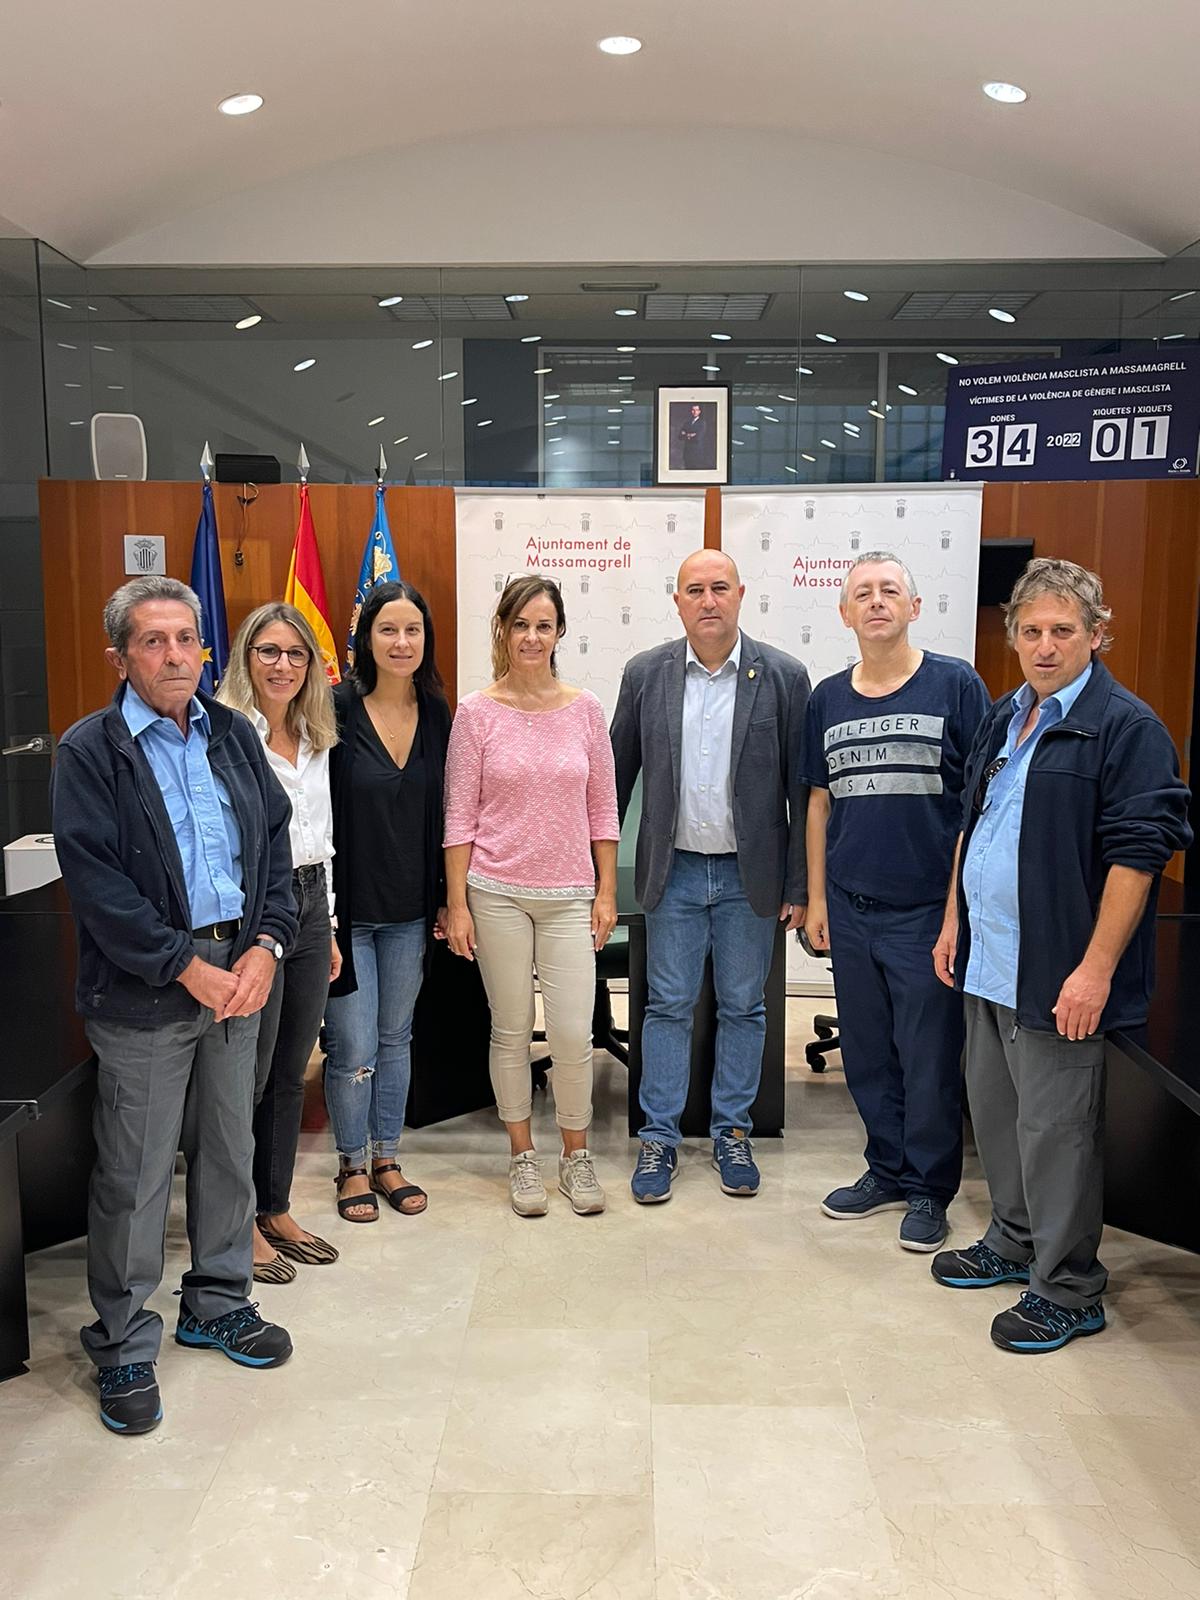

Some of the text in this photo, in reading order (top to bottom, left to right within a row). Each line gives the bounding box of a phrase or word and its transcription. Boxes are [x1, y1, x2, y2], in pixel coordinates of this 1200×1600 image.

[959, 379, 971, 387] NO
[973, 376, 1001, 385] VOLEM
[1049, 368, 1099, 379] MASCLISTA
[1101, 367, 1108, 375] A
[1110, 362, 1187, 375] MASSAMAGRELL
[969, 395, 1004, 405] VÍCTIMES
[1006, 394, 1017, 402] DE
[1018, 394, 1028, 402] LA
[1072, 389, 1083, 398] DE
[1122, 383, 1171, 394] MASCLISTA
[990, 414, 1016, 423] DONES
[1093, 404, 1173, 416] XIQUETES I XIQUETS
[1046, 432, 1080, 447] 2022
[526, 536, 631, 553] Ajuntament de
[526, 554, 631, 572] Massamagrell
[793, 556, 854, 573] Ajuntam
[793, 574, 842, 587] Massa
[828, 718, 918, 742] HILFIGER
[828, 747, 887, 770] DENIM
